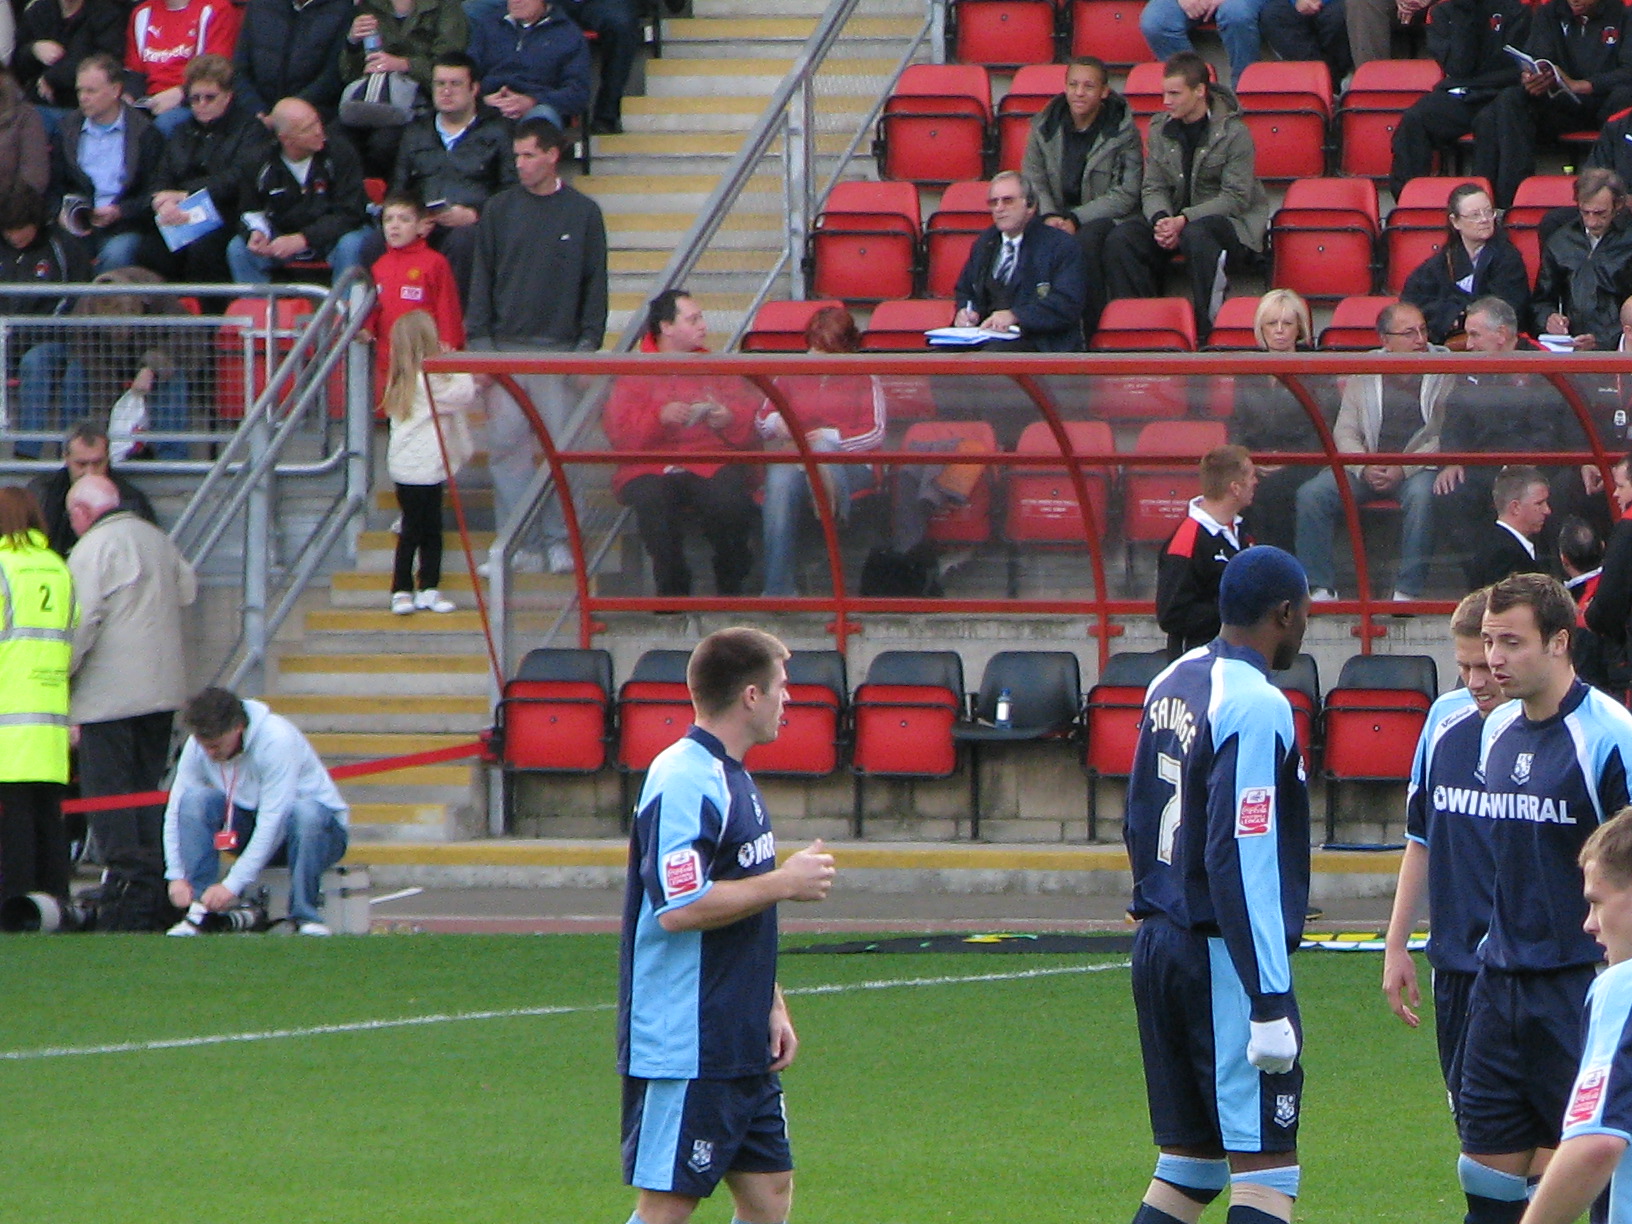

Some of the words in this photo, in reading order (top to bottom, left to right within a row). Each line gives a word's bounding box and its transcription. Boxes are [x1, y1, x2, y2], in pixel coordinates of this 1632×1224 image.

[39, 584, 52, 612] 2
[1156, 752, 1182, 866] 7
[1489, 793, 1578, 824] WIRRAL
